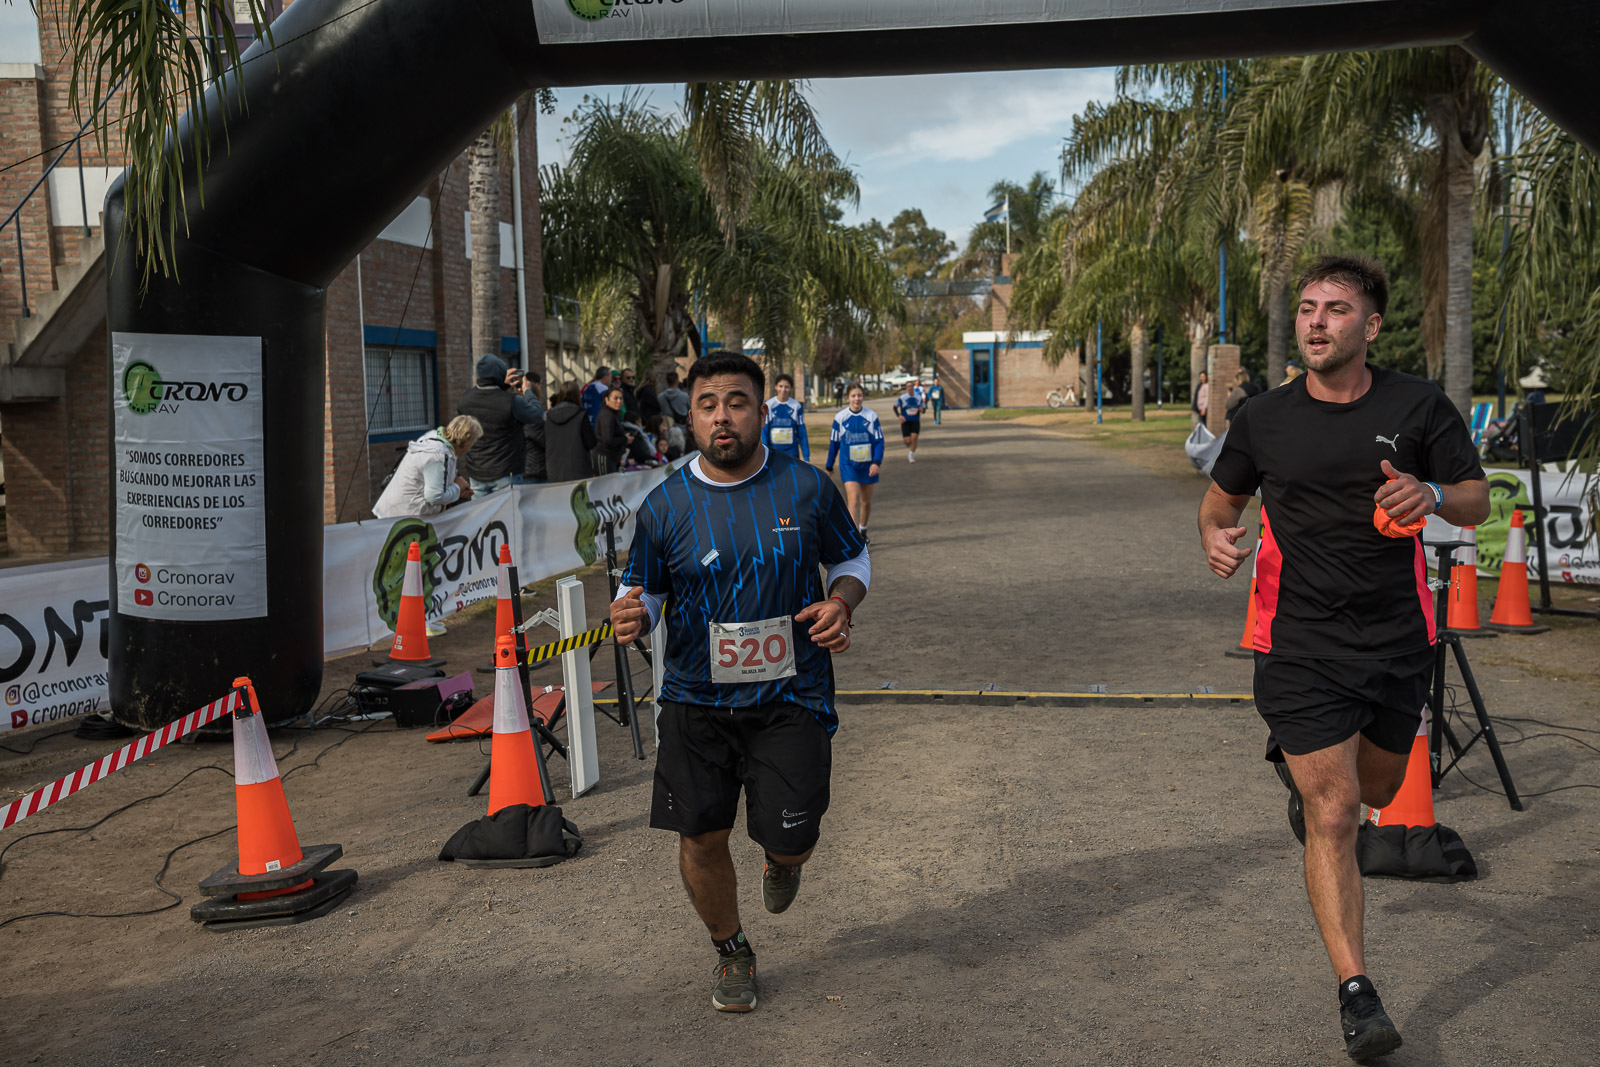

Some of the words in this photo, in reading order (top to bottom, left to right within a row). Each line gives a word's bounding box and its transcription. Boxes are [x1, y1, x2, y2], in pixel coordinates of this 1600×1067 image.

[599, 8, 630, 19] RAV
[148, 380, 249, 403] CRONO
[147, 403, 180, 414] RAV
[164, 453, 245, 467] CORREDORES
[120, 470, 168, 487] BUSCANDO
[172, 475, 231, 488] MEJORAR
[234, 474, 256, 487] LAS
[127, 491, 200, 509] EXPERIENCIAS
[203, 495, 219, 509] DE
[223, 495, 245, 508] LOS
[157, 568, 235, 585] Cronorav
[157, 590, 236, 607] Cronorav
[717, 633, 787, 669] 520
[32, 696, 101, 725] cronorav
